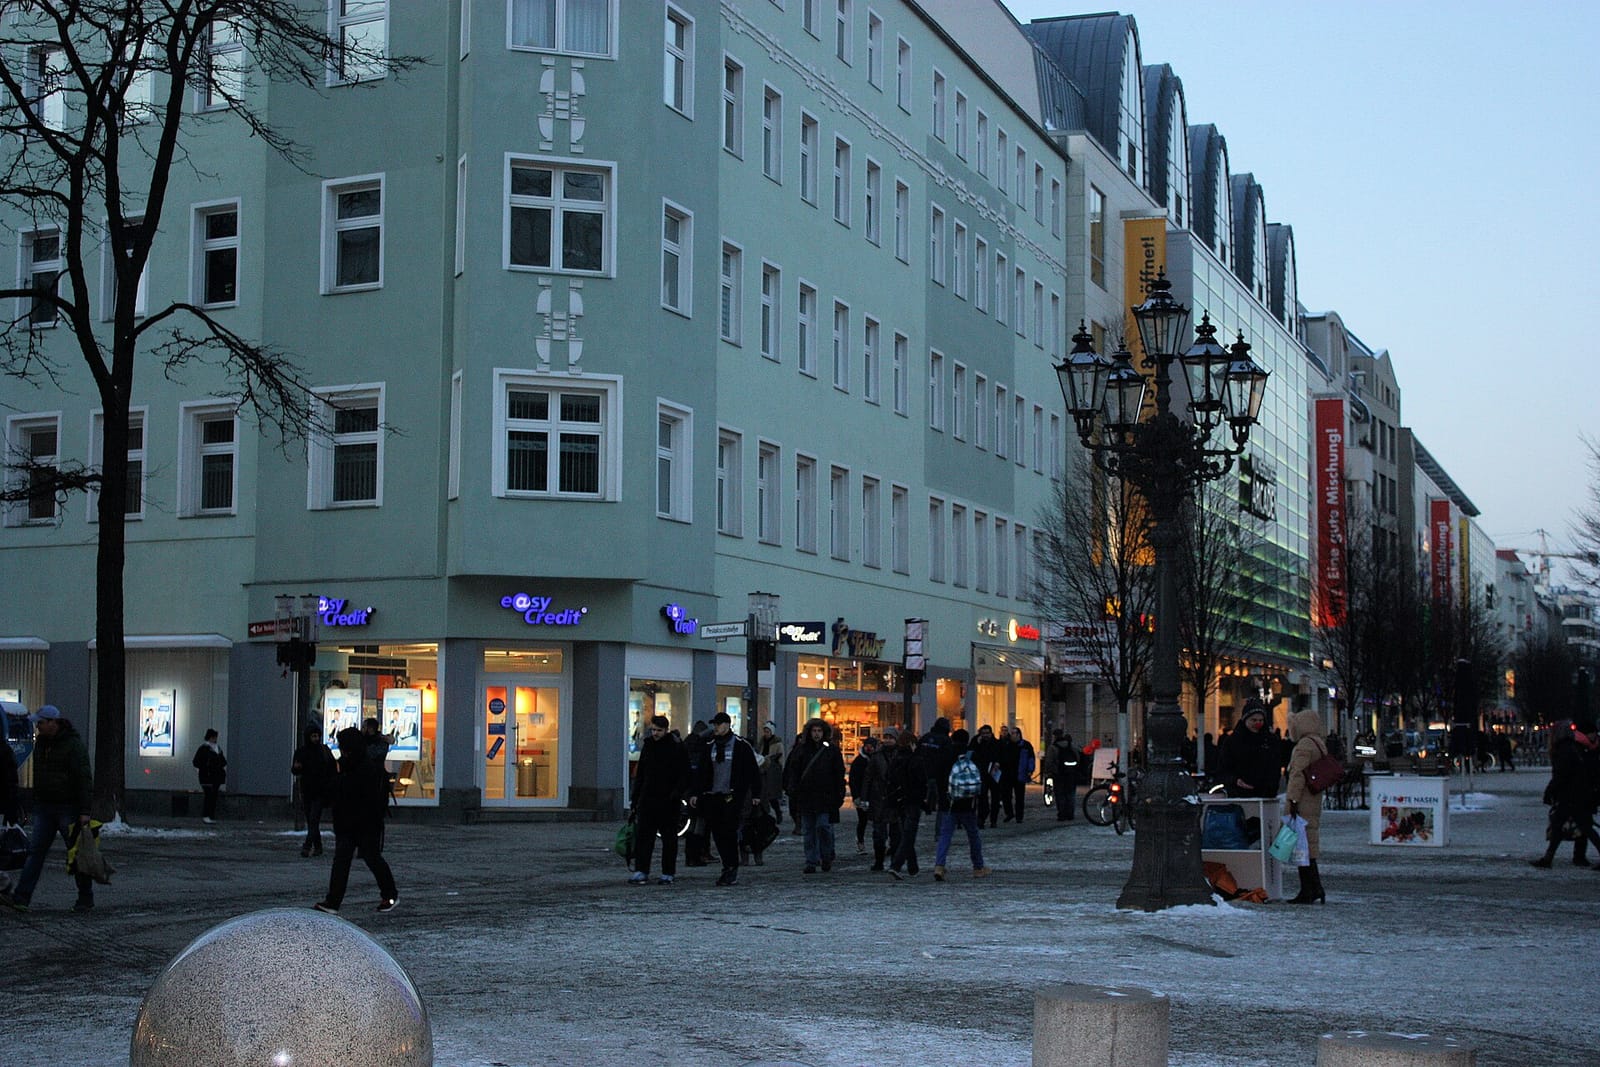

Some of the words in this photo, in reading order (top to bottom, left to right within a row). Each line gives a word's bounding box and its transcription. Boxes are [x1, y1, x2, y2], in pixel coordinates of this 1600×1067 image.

[1139, 236, 1156, 303] öffnet!
[1325, 427, 1342, 505] Mischung!
[323, 609, 368, 626] Credit
[524, 608, 582, 625] Credit
[675, 618, 696, 634] Credit
[791, 631, 818, 642] Credit
[1413, 796, 1439, 804] NASEN
